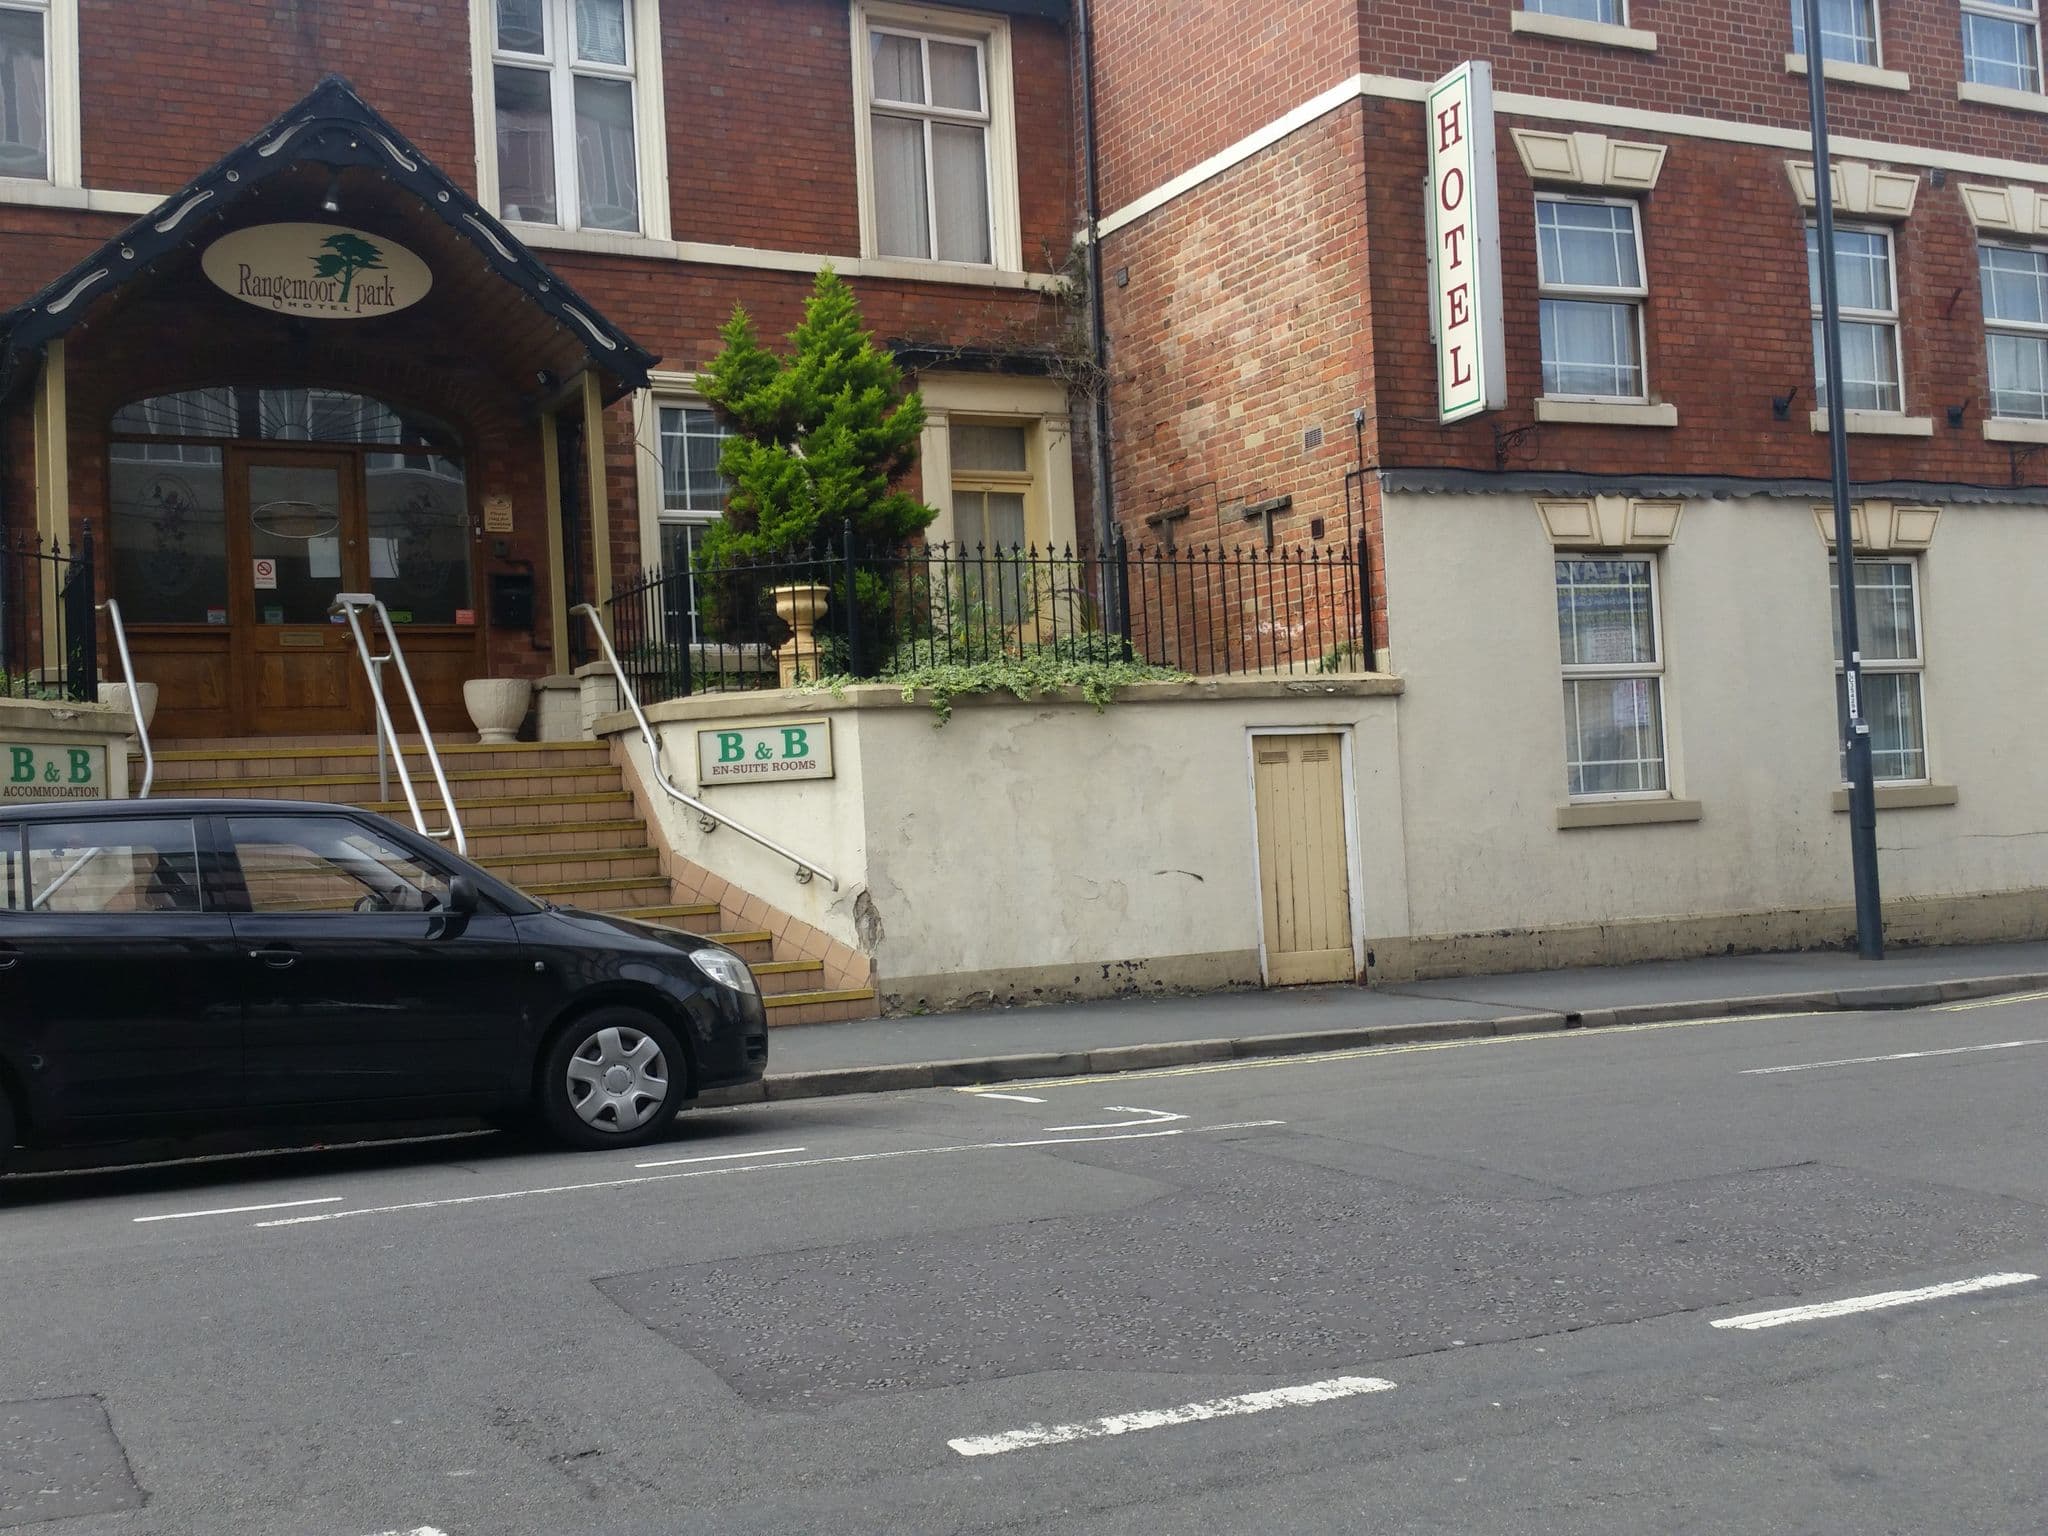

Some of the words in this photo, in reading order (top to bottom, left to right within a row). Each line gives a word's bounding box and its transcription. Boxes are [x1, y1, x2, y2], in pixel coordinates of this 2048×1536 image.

[1437, 101, 1471, 388] HOTEL
[238, 263, 337, 309] Rangemoor
[356, 275, 394, 313] park
[288, 302, 351, 312] HOTEL
[716, 732, 745, 762] B
[754, 742, 773, 760] &
[780, 728, 809, 758] B
[10, 747, 35, 782] B
[44, 762, 60, 783] &
[67, 749, 92, 783] B
[712, 763, 769, 775] EN-SUITE
[772, 760, 816, 772] ROOMS
[3, 786, 99, 798] ACCOMMODATION
